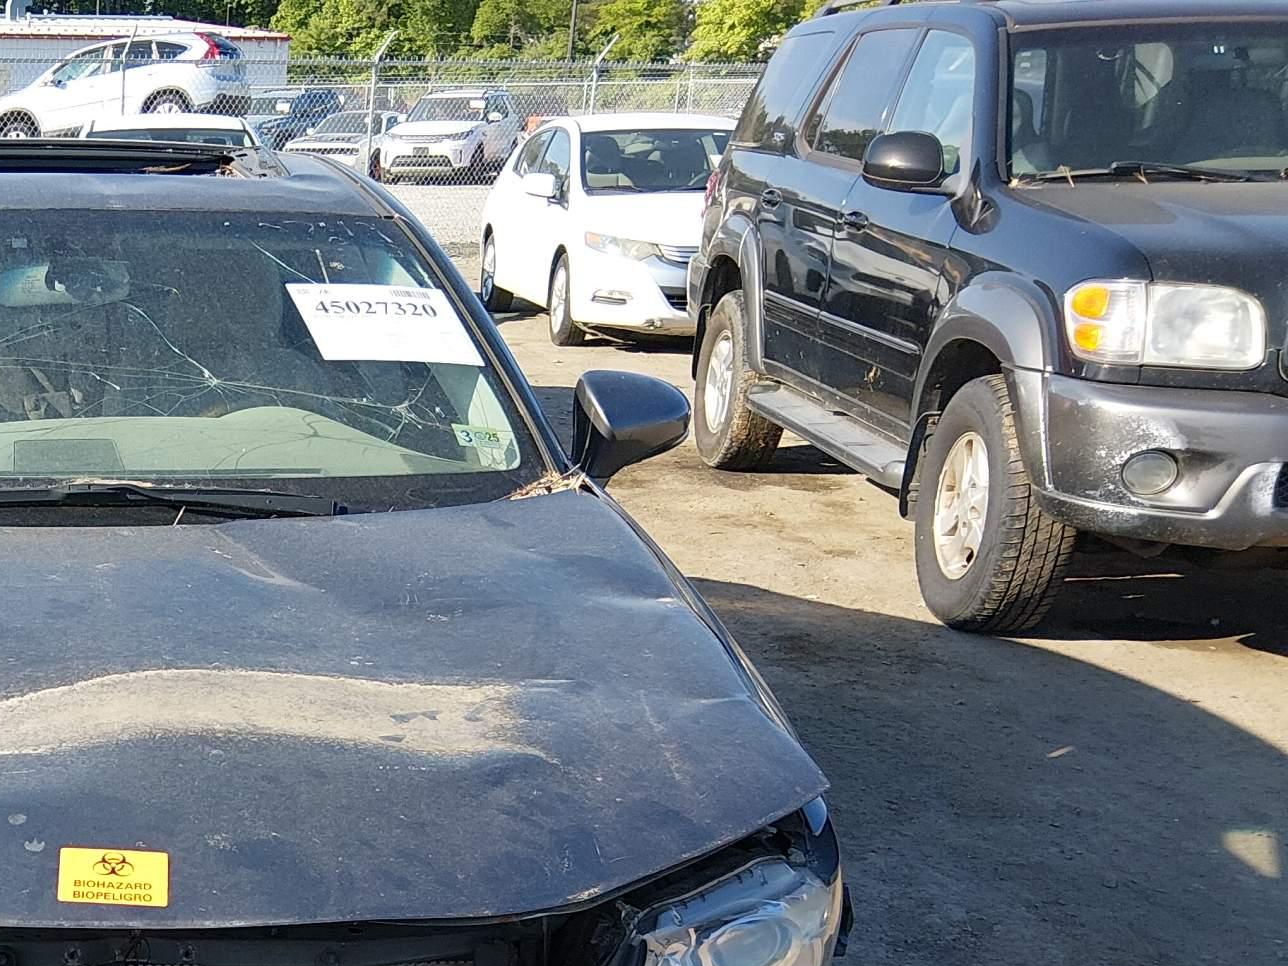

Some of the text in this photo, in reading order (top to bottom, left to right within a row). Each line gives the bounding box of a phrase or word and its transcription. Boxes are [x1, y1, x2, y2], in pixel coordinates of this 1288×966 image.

[314, 300, 438, 318] 45027320
[460, 430, 500, 443] 3 25
[73, 879, 153, 891] BIOHAZARD
[72, 890, 153, 903] BIOPELIGRO
